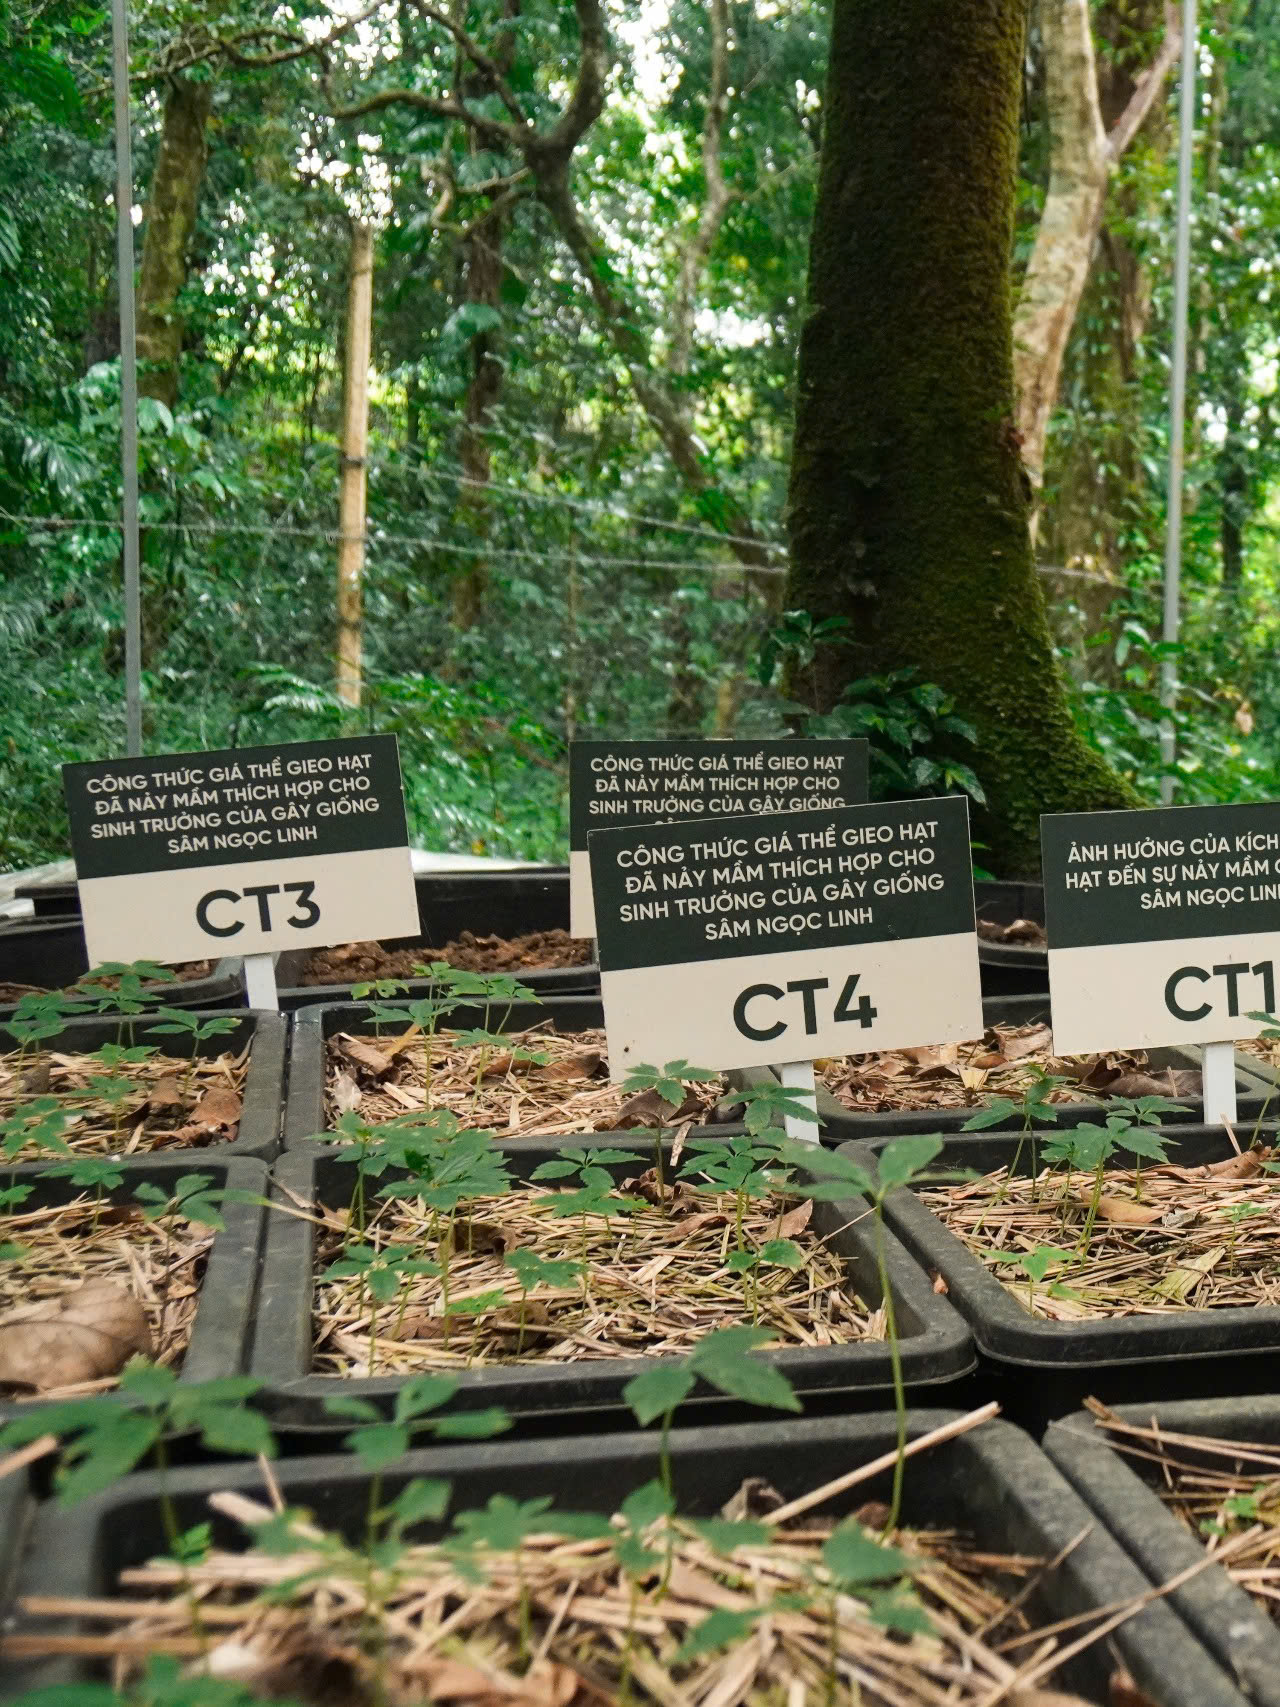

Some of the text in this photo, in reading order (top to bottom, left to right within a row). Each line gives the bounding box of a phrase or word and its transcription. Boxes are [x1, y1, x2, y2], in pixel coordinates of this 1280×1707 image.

[86, 773, 147, 794] CÔNG
[209, 763, 244, 783] GIÁ
[287, 758, 332, 775] GIEO
[337, 754, 372, 773] HẠT
[591, 755, 644, 771] CÔNG
[699, 754, 728, 771] GIÁ
[768, 757, 808, 769] GIEO
[814, 756, 844, 774] HẠT
[95, 798, 123, 815] ĐÃ
[223, 783, 279, 803] THÍCH
[285, 781, 323, 800] HỢP
[329, 776, 370, 793] CHO
[595, 775, 619, 792] ĐÃ
[709, 774, 758, 790] THÍCH
[764, 776, 798, 794] HỢP
[803, 776, 840, 789] CHO
[91, 822, 136, 839] SINH
[271, 803, 311, 821] GÂY
[316, 794, 380, 816] GIỐNG
[589, 800, 627, 814] SINH
[168, 826, 317, 854] SÂM NGỌC LINH
[617, 821, 938, 868] CÔNG THỨC GIÁ THỂ GIEO HẠT
[1068, 842, 1108, 863] ẢNH
[1114, 837, 1184, 860] HƯỞNG
[1190, 833, 1230, 854] CỦA
[1235, 831, 1279, 851] KÍCH
[625, 848, 935, 894] ĐÃ NẢY MẦM THÍCH HỢP CHO
[1065, 871, 1102, 892] HẠT
[1108, 862, 1147, 886] ĐẾN
[1152, 865, 1177, 886] SỰ
[1182, 860, 1220, 881] NẢY
[1225, 855, 1270, 878] MẦM
[196, 881, 320, 937] CT3
[620, 869, 945, 923] SINH TRƯỞNG CỦA GÂY GIỐNG
[1140, 889, 1181, 910] SÂM
[1187, 886, 1245, 908] NGỌC
[705, 907, 873, 941] SÂM NGỌC LINH
[733, 974, 878, 1041] CT4
[1164, 961, 1276, 1022] CT1
